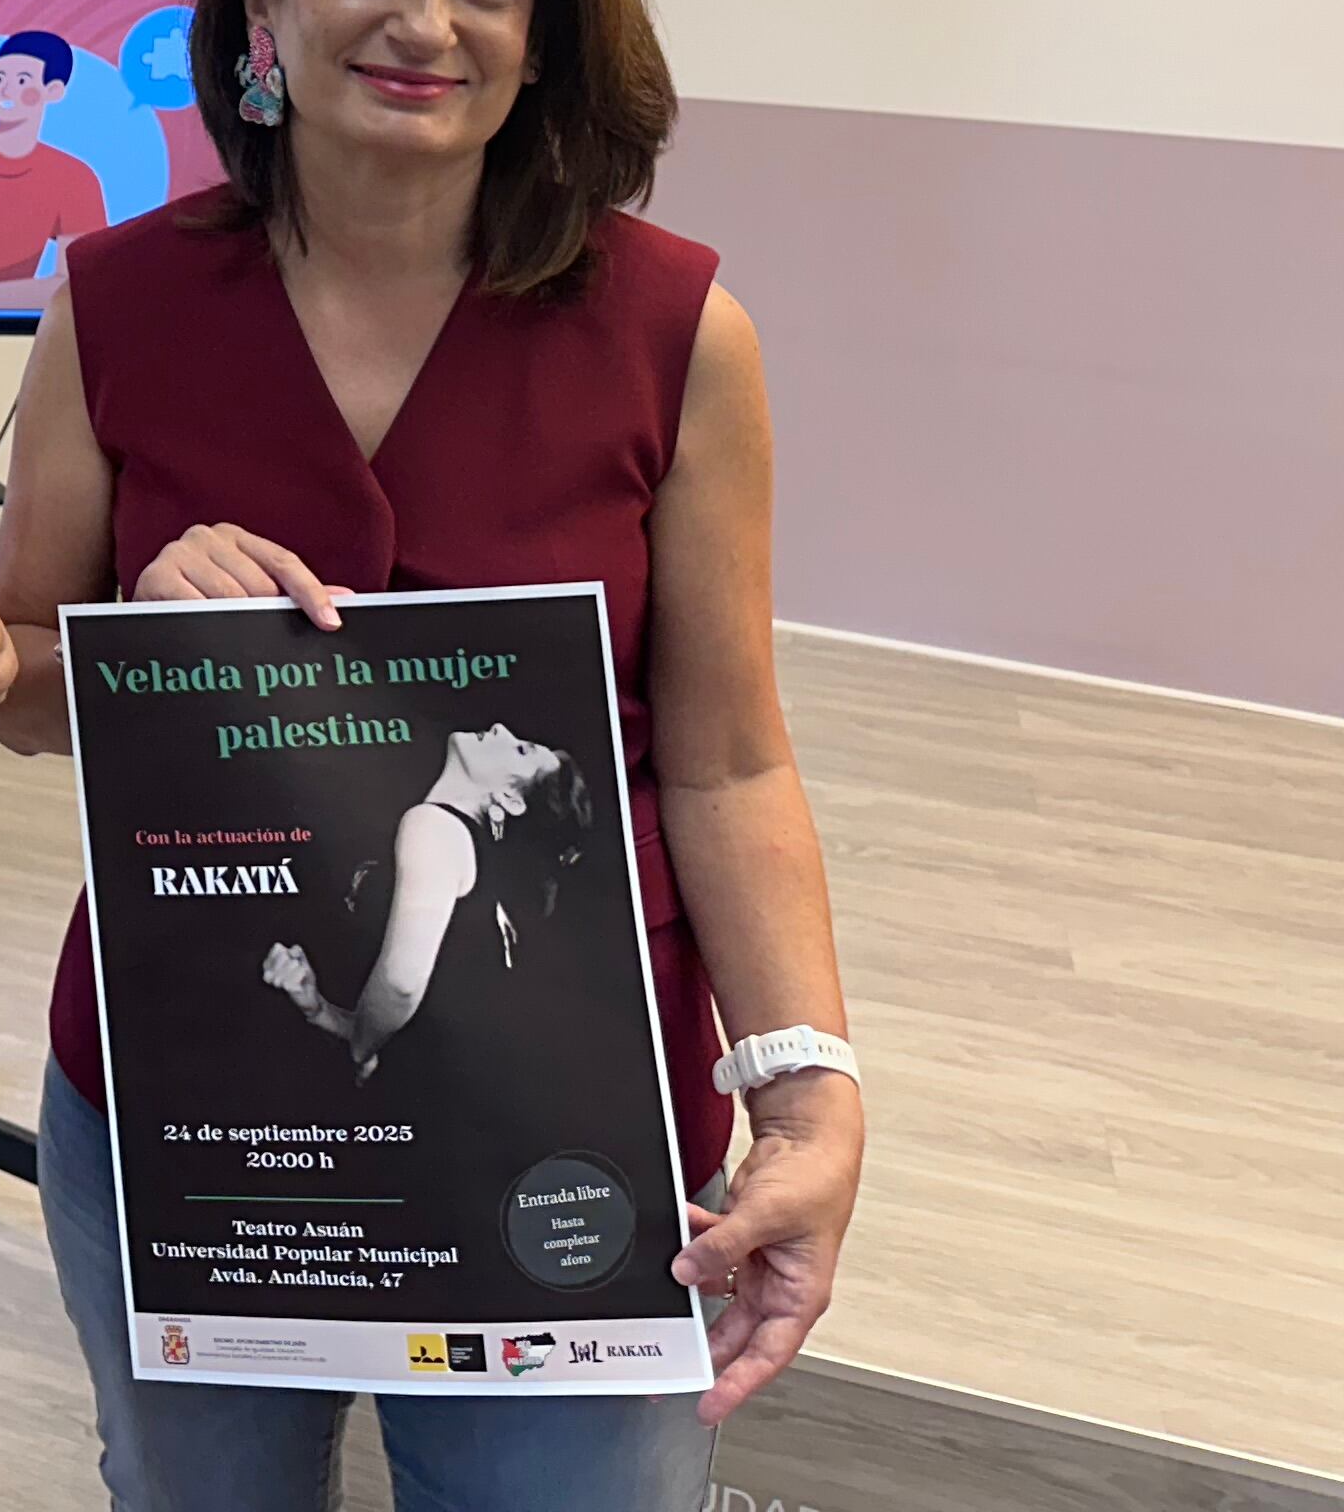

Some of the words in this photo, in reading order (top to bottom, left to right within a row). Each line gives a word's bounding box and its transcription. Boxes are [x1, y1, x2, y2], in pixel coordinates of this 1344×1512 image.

[98, 658, 243, 694] Velada
[253, 660, 322, 697] por
[334, 653, 374, 686] la
[386, 648, 517, 688] mujer
[216, 712, 412, 759] palestina
[135, 830, 170, 845] Con
[174, 829, 192, 845] la
[196, 828, 286, 844] actuación
[290, 827, 312, 842] de
[151, 857, 299, 895] RAKATÁ
[163, 1125, 192, 1141] 24
[197, 1124, 223, 1141] de
[228, 1124, 348, 1146] septiembre
[354, 1125, 414, 1142] 2025
[246, 1151, 314, 1169] 20:00
[320, 1151, 335, 1169] h
[517, 1188, 576, 1208] Entrada
[576, 1185, 611, 1201] libre
[232, 1219, 297, 1237] Teatro
[302, 1221, 365, 1238] Asuán
[551, 1217, 585, 1230] Hasta
[543, 1234, 600, 1250] completar
[151, 1242, 268, 1261] Universidad
[274, 1245, 353, 1265] Popular
[358, 1247, 459, 1268] Municipal
[560, 1254, 592, 1267] aforo
[209, 1268, 263, 1284] Avda.
[268, 1269, 374, 1290] Andalucía,
[380, 1272, 404, 1288] 47
